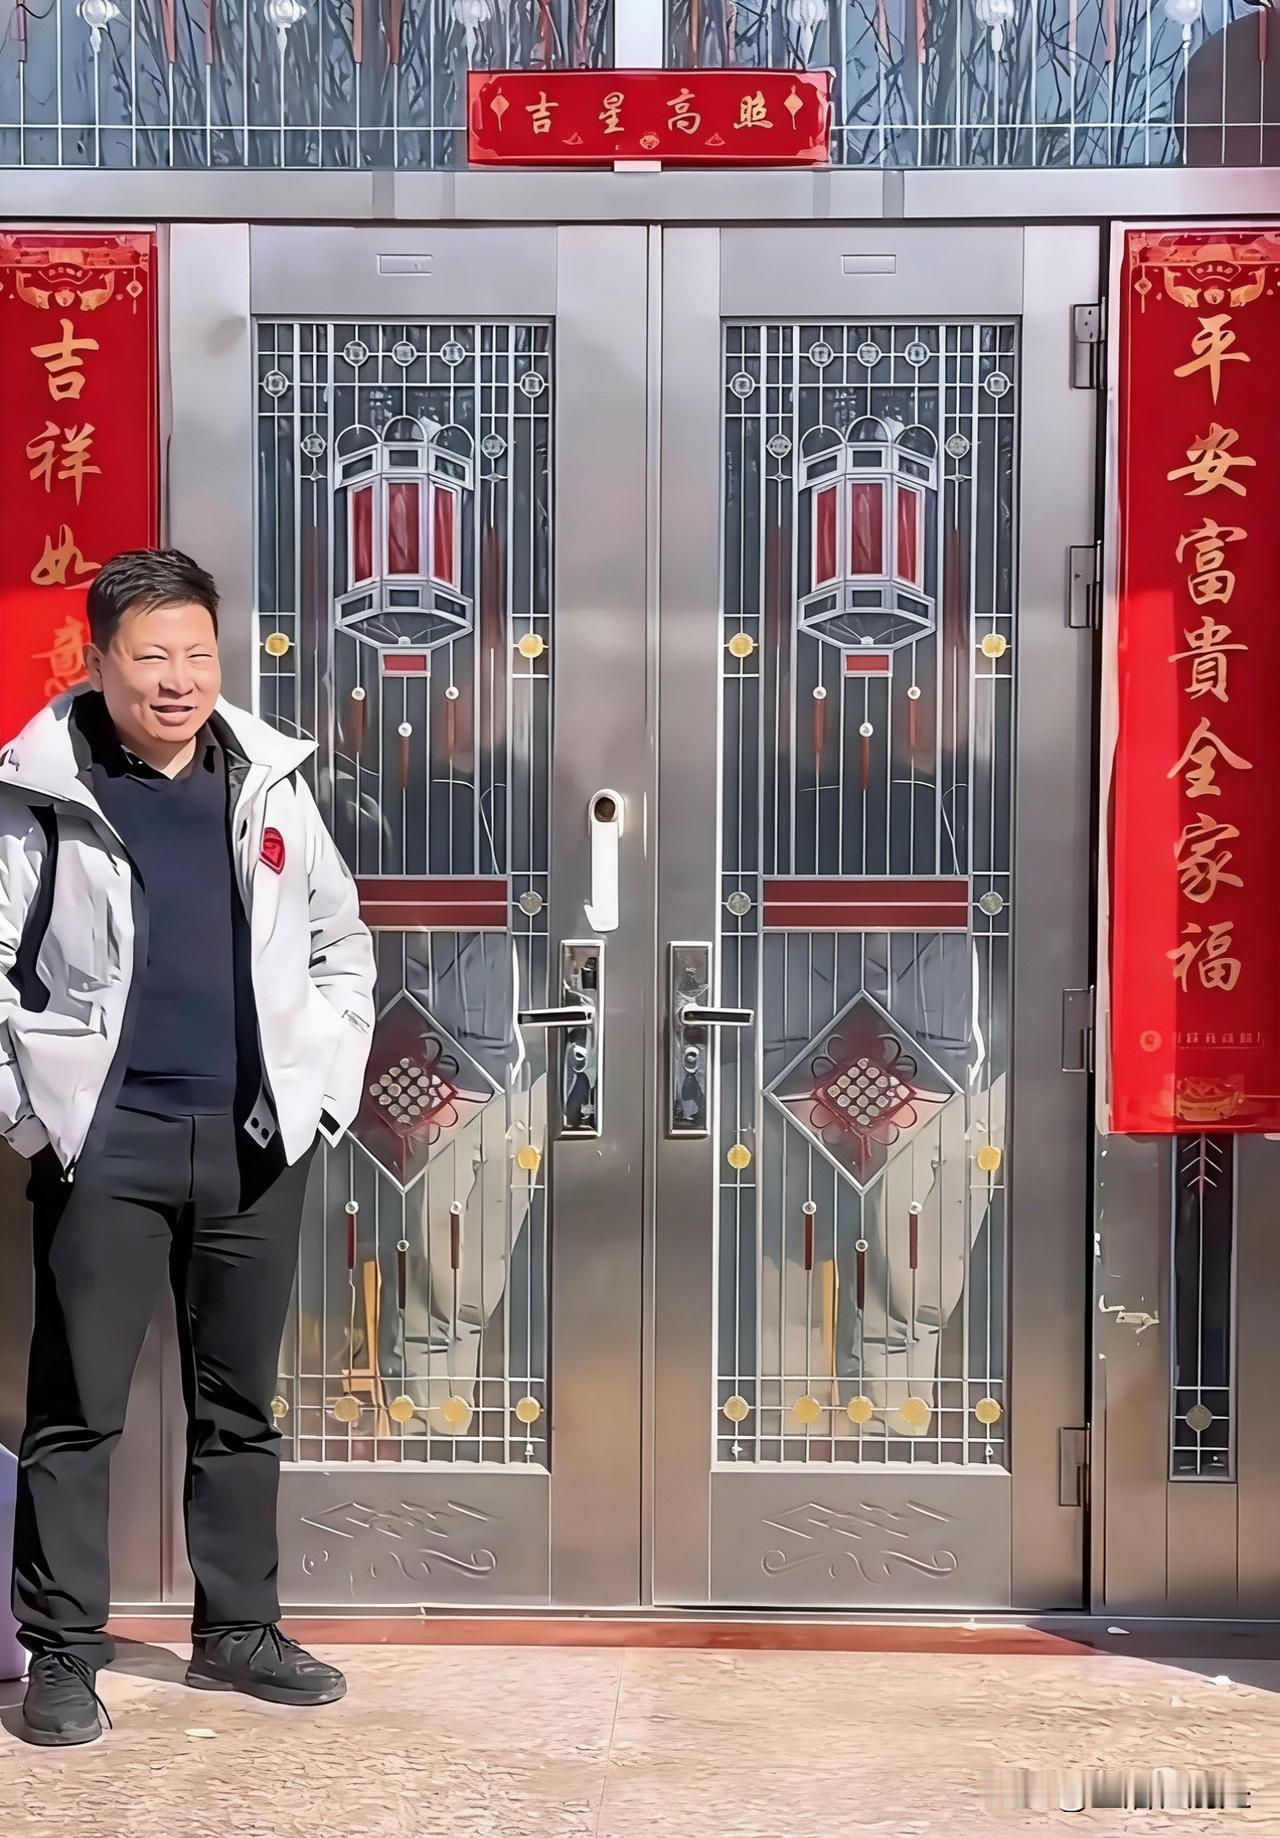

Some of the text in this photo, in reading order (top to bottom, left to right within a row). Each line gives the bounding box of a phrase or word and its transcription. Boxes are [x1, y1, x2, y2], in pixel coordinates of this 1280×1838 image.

[524, 88, 774, 135] 吉星高照
[1165, 313, 1257, 993] 平安富貴全家福
